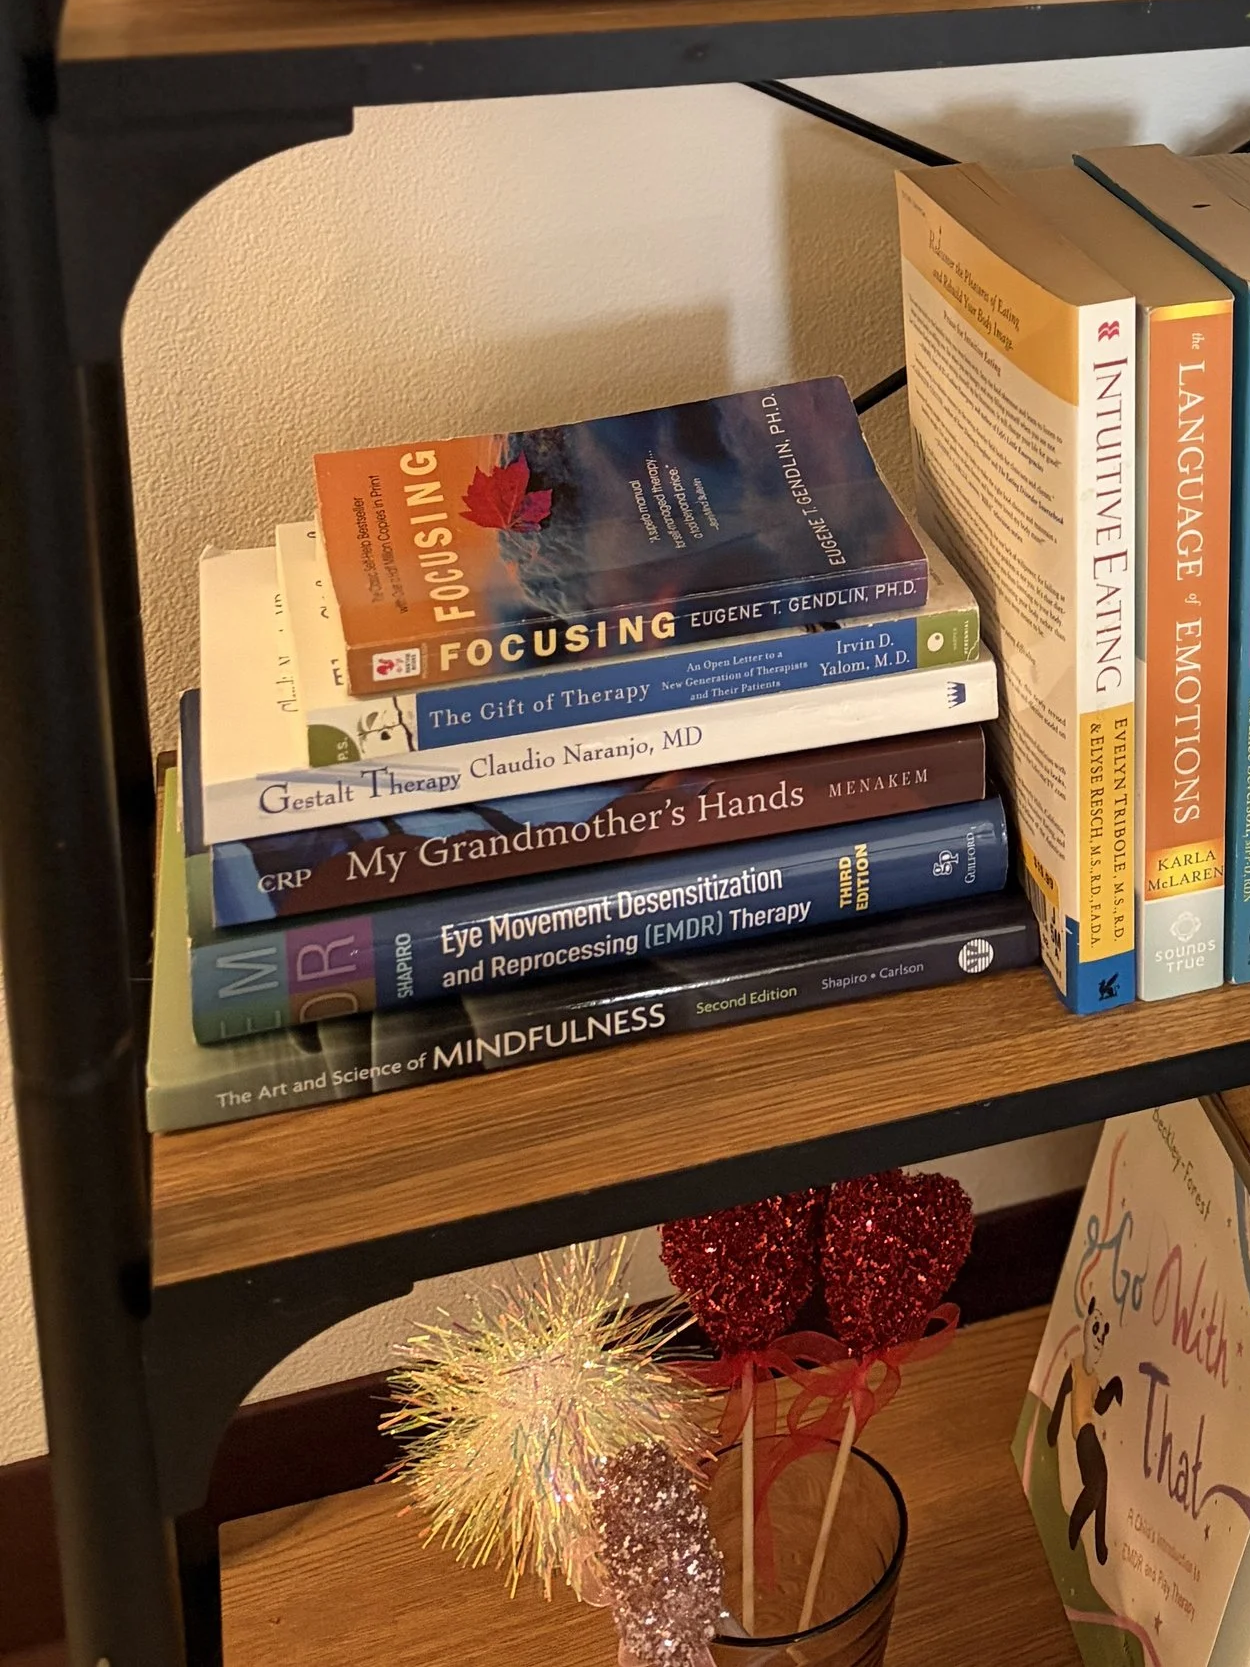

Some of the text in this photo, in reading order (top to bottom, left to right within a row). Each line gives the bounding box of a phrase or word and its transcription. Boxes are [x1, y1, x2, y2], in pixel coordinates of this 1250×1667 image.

[762, 392, 846, 566] EUGENE T. GENDLIN, PH.D.
[399, 449, 477, 623] FOCUSING
[1093, 357, 1128, 692] INTUITIVE EATING
[691, 580, 917, 628] EUGENE T. GENDLIN, PH.D.
[1173, 332, 1205, 825] the LANGUAGE of EMOTIONS
[440, 611, 676, 671] FOCUSING
[662, 660, 808, 691] New Generation Therapists
[687, 651, 783, 672] An Open Letter to a
[820, 659, 870, 678] Yalom,
[836, 633, 894, 654] Irvin D.
[429, 683, 651, 728] The Gift of Therapy
[690, 679, 781, 701] and Their Patients
[259, 725, 703, 814] Gestalt Therapy Claudio Naranjo, MD
[1113, 717, 1127, 788] EVELYN
[1089, 735, 1105, 843] ELYSE RESCH,
[258, 768, 929, 894] CRP My Grandmother's Hands MENAKEM
[1157, 849, 1217, 872] KARLA
[441, 866, 783, 955] Eye Movement Desensitization
[839, 855, 853, 909] THIRD
[855, 843, 868, 911] EDITION
[1147, 865, 1224, 892] McLAREN
[395, 932, 414, 998] SHAPIRO
[442, 898, 812, 988] and Reprocessing (EMDR) Therapy
[216, 961, 924, 1108] The Art and Science of MINDFULNESS Second Edition Shapiro Carlson
[1086, 1210, 1229, 1388] Go With
[1139, 1361, 1230, 1521] That
